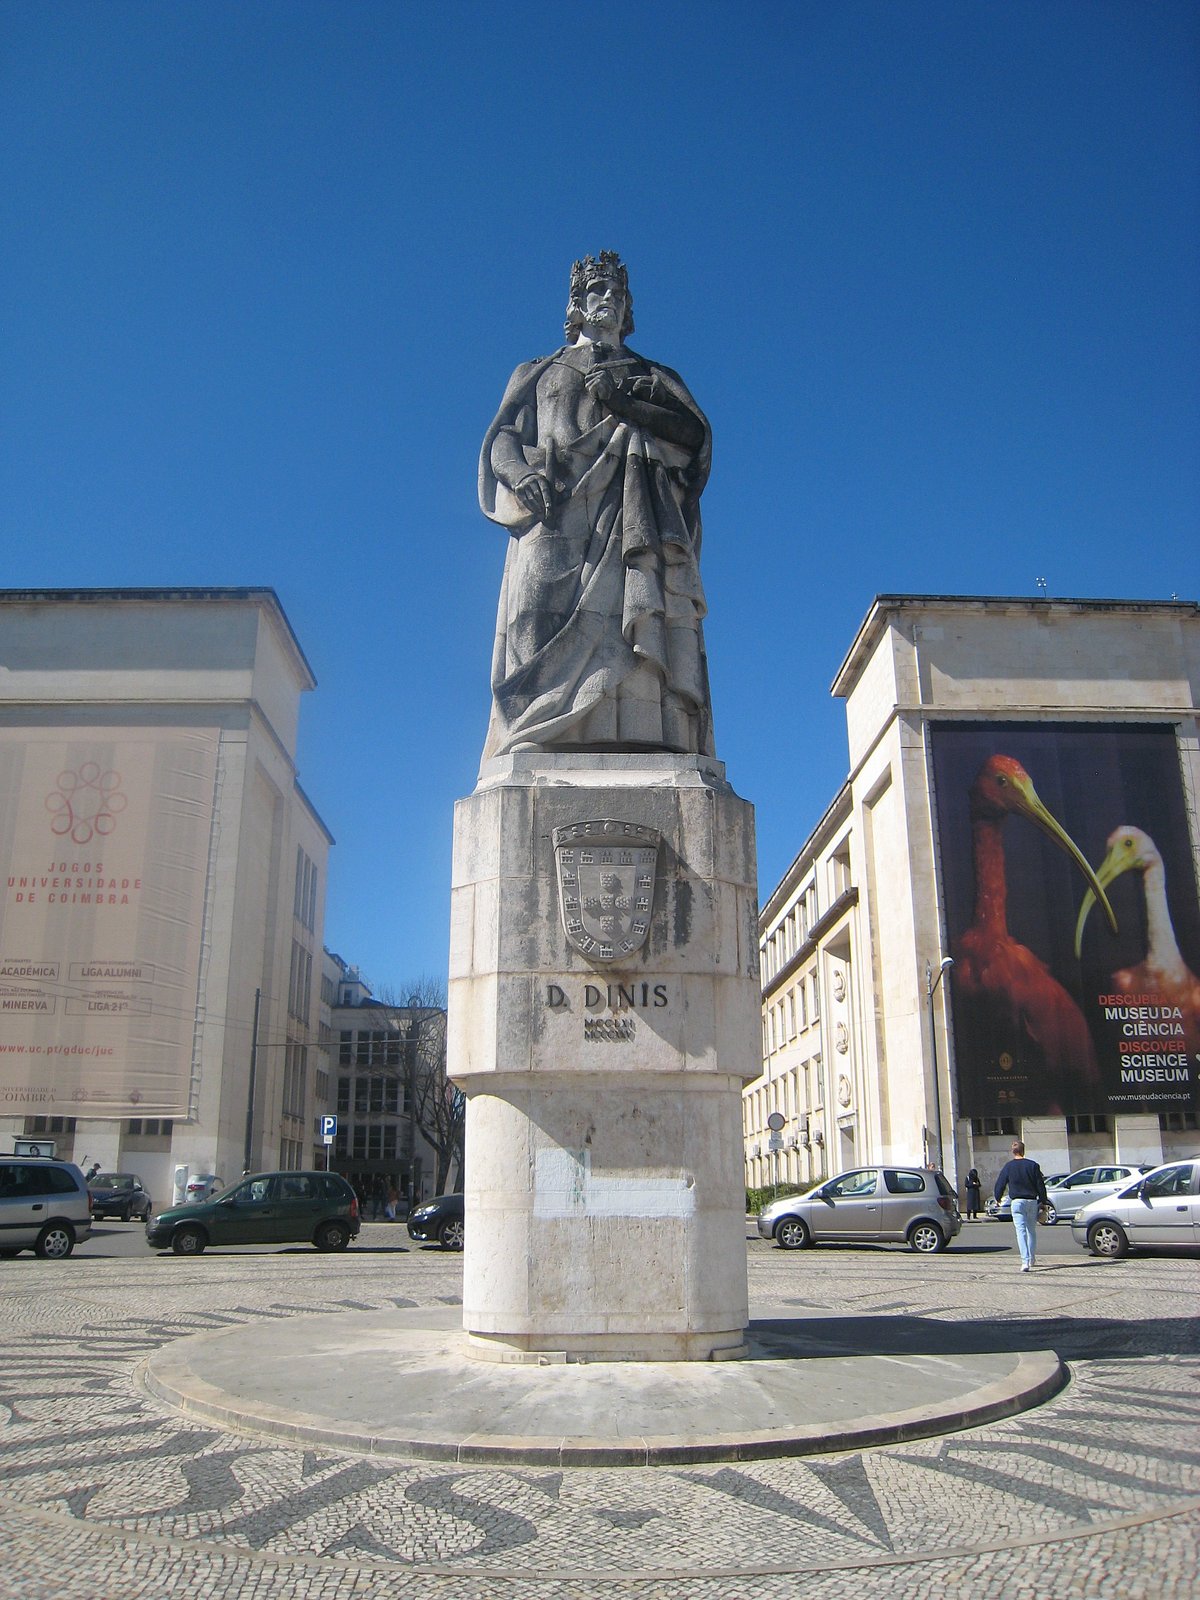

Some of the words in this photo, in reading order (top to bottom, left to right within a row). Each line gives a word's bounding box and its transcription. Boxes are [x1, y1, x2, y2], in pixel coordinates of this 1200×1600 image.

[48, 862, 104, 873] JOGOS
[7, 877, 142, 889] UNIVERSIDADE
[16, 892, 36, 903] DE
[48, 892, 129, 905] COIMBRA
[0, 965, 56, 977] ACADÉMICA
[81, 967, 103, 977] LIGA
[103, 967, 142, 978] ALUMNI
[546, 984, 568, 1008] D.
[584, 982, 669, 1008] DINIS
[2, 1000, 48, 1010] MINERVA
[1104, 1006, 1159, 1020] MUSEU
[1160, 1006, 1183, 1020] DA
[1122, 1020, 1185, 1036] CIÊNCIA
[0, 1044, 114, 1057] www.uc.pt/gduc/juc
[1118, 1040, 1186, 1053] DISCOVER
[1120, 1053, 1188, 1068] SCIENCE
[1120, 1068, 1190, 1083] MUSEUM
[1107, 1092, 1191, 1101] www.museudaciencia.pt
[324, 1117, 334, 1135] P
